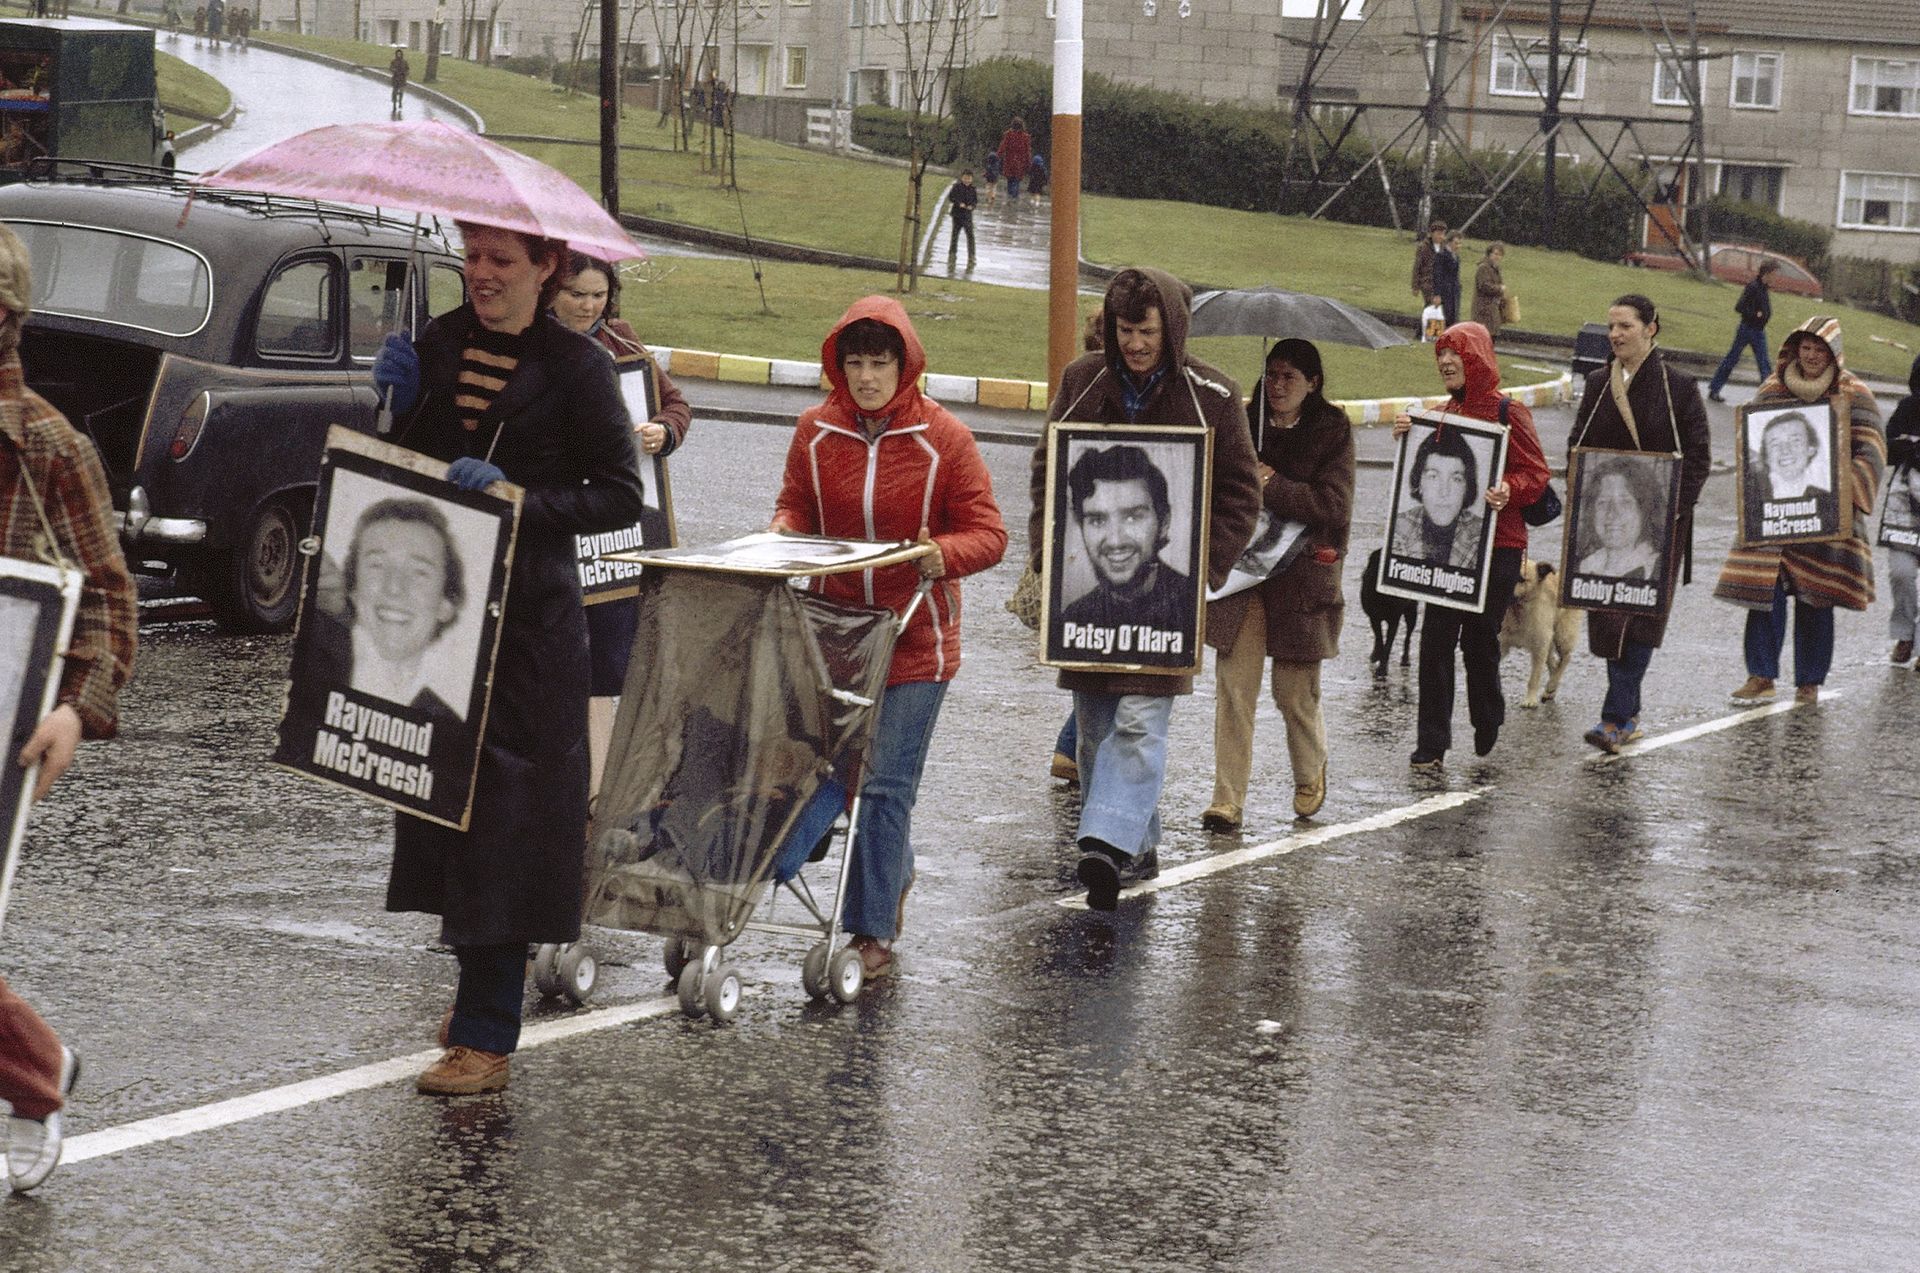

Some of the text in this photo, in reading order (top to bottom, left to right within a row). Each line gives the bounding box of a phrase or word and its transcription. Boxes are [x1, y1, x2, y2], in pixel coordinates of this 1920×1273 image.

[1764, 498, 1816, 519] Raymond
[1762, 516, 1821, 536] McCreesh
[1388, 558, 1475, 595] Francis Hughes
[1571, 577, 1658, 607] Bobby Sands
[1063, 622, 1183, 654] Patsy O'Hara
[324, 691, 434, 758] Raymond
[312, 729, 434, 801] McCreesh
